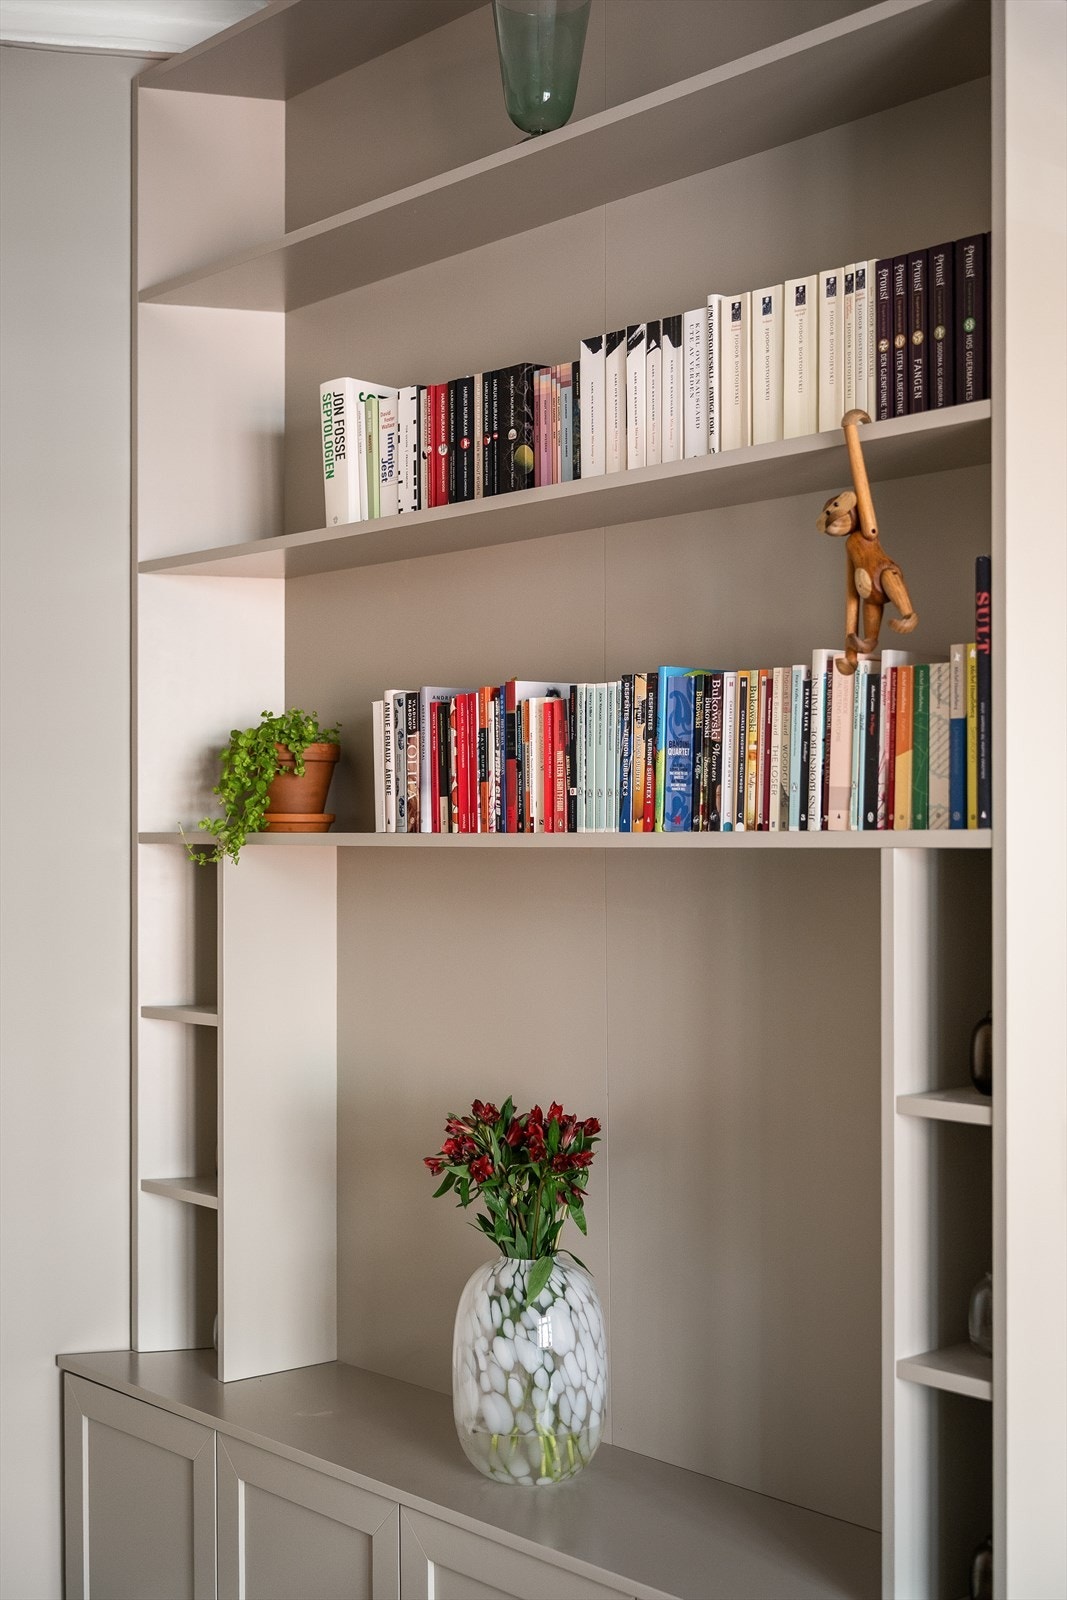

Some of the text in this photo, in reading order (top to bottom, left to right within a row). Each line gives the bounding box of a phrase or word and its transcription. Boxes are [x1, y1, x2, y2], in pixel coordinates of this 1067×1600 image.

[894, 264, 905, 296] Proust
[912, 260, 923, 292] Proust
[934, 254, 945, 287] Proust
[964, 244, 975, 278] Proust
[878, 268, 890, 301] Proust
[690, 347, 694, 357] AV
[914, 358, 922, 400] FANGEN
[322, 392, 336, 480] SEPTOLOGIEN
[332, 392, 346, 462] JON FOSSE
[380, 458, 389, 484] Jest
[386, 432, 396, 478] Infinite
[976, 591, 991, 654] SULT
[704, 696, 712, 739] Bukowski
[749, 685, 758, 733] Bukowski
[668, 748, 690, 756] QUARTET
[711, 680, 721, 783] Bukowski Women
[406, 734, 418, 801] LOLITA
[810, 727, 818, 791] BJØRNEBOE
